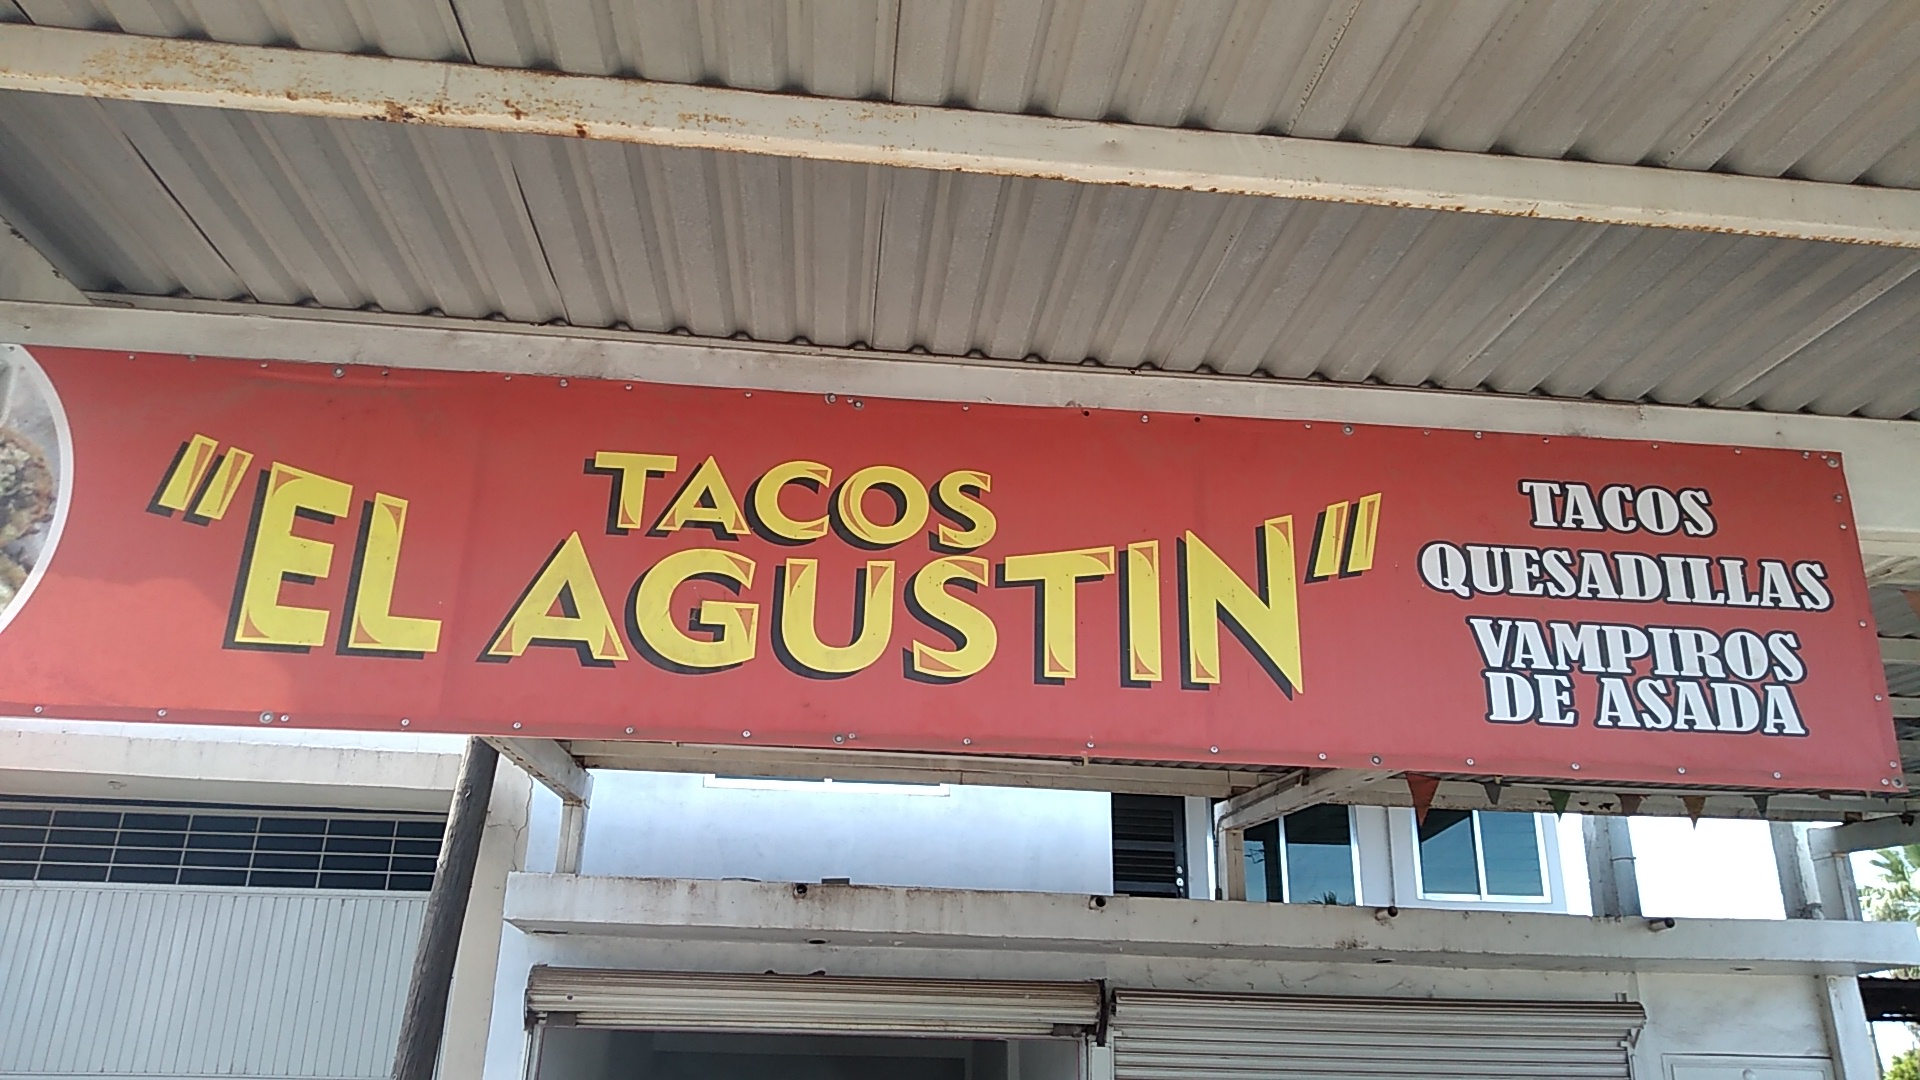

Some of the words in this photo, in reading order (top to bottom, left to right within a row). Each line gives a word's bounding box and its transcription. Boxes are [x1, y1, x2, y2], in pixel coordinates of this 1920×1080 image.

[586, 451, 998, 551] TACOS
[1521, 479, 1716, 537] TACOS
[1420, 542, 1832, 611] QUESADILLAS
[1469, 617, 1807, 683] VAMPIROS
[1485, 670, 1578, 726] DE
[1598, 677, 1807, 736] ASADA
